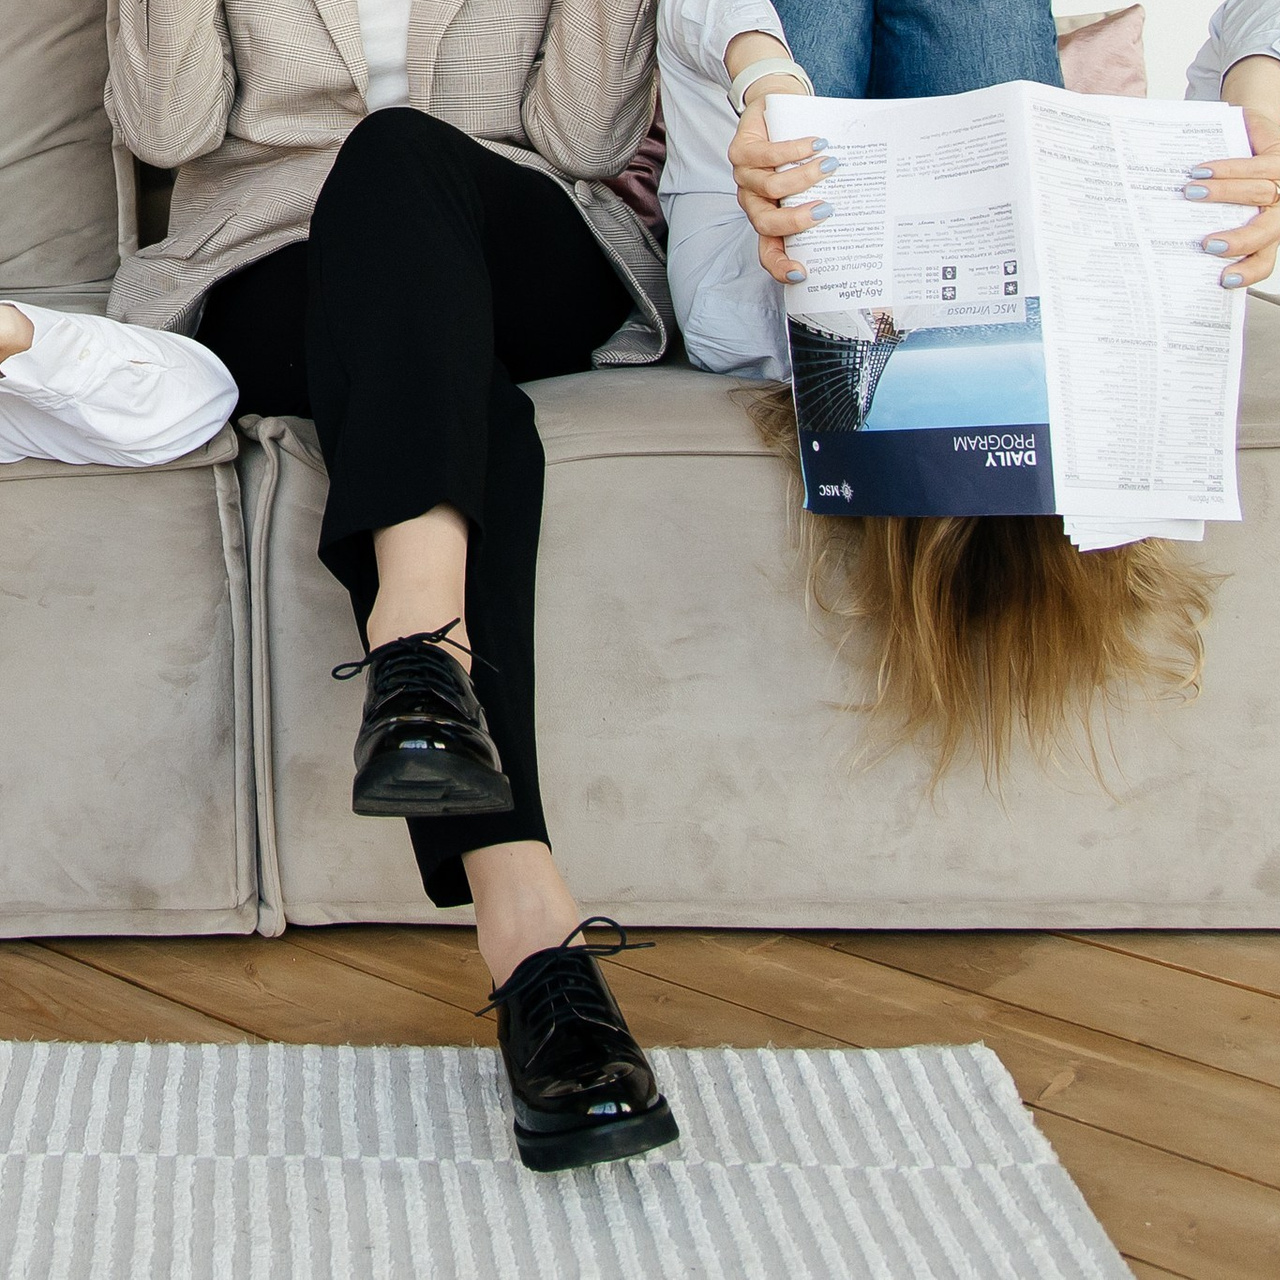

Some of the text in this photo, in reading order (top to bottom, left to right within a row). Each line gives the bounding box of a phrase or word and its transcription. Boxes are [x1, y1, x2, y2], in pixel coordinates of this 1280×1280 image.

[810, 261, 883, 274] События сегодня
[820, 282, 847, 291] Декабря
[858, 278, 883, 287] Среда,
[839, 288, 883, 299] Абу-Даби
[947, 303, 1017, 316] MSC Virtuosa
[953, 434, 1035, 451] PROGRAM
[985, 450, 1036, 467] DAILY
[819, 485, 840, 496] MSC
